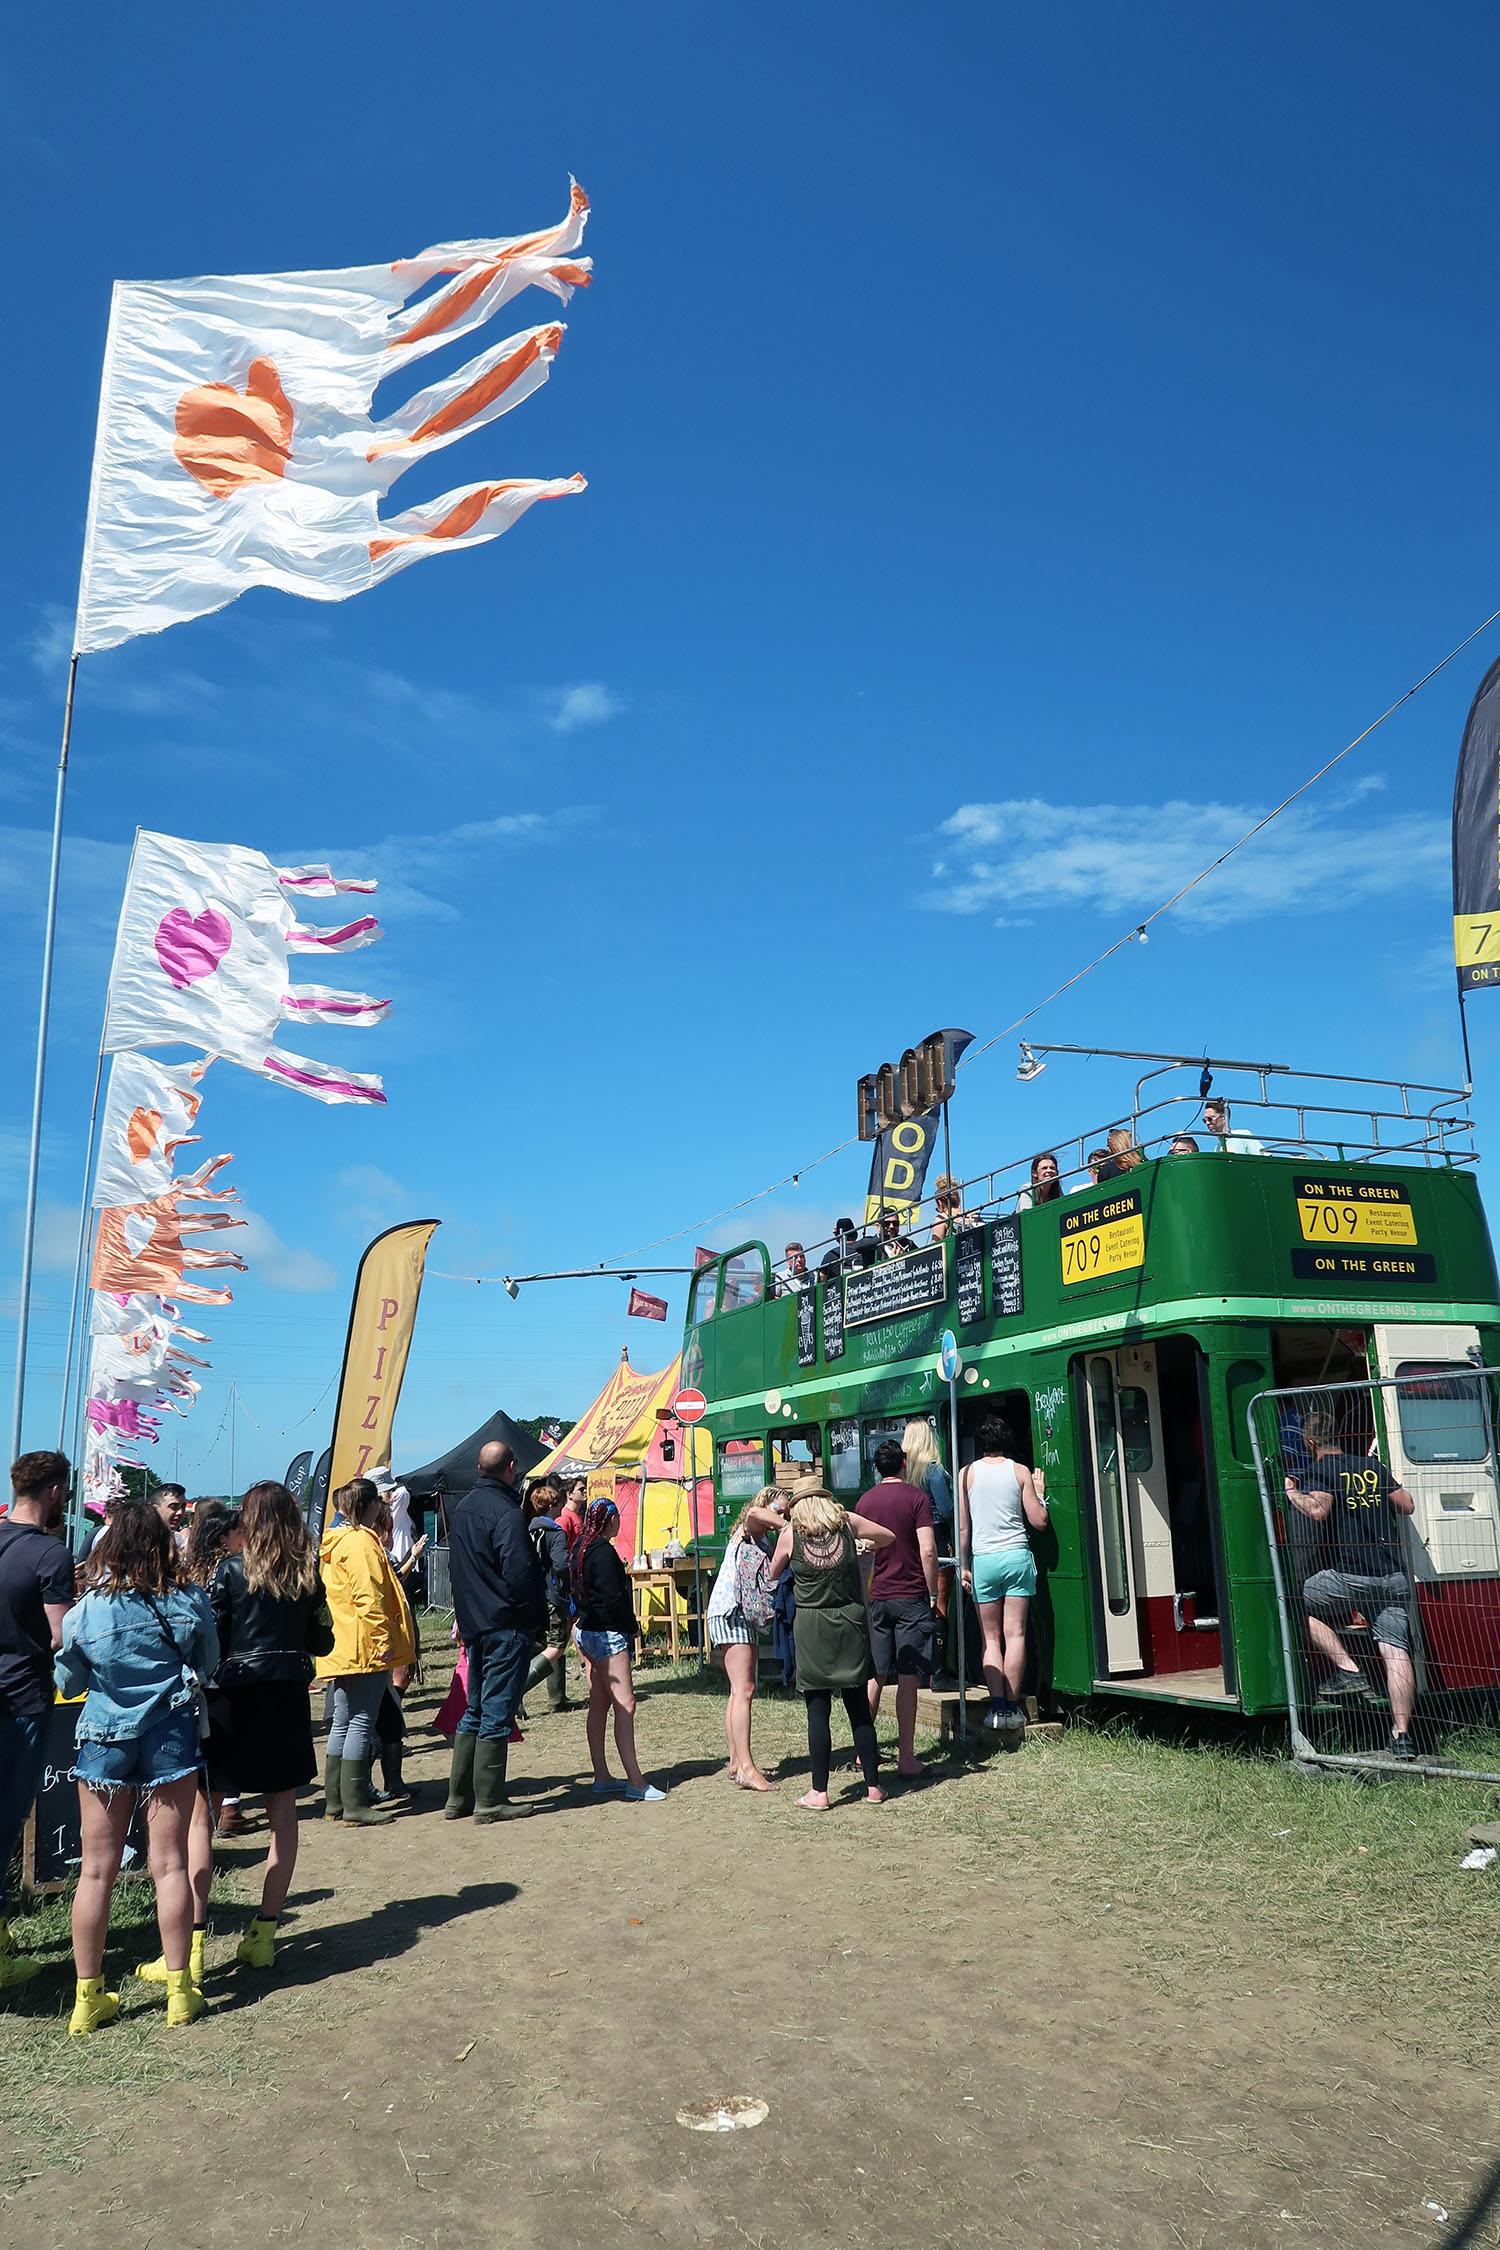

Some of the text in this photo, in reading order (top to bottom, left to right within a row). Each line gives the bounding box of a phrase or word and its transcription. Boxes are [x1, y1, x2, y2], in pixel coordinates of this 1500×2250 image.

[1472, 968, 1489, 981] ON
[1304, 1184, 1400, 1199] ON THE GREEN
[1066, 1198, 1134, 1230] ON THE GREEN
[1304, 1205, 1358, 1235] 709
[1369, 1209, 1402, 1218] Restaurant
[1365, 1219, 1410, 1229] Event Catering
[1109, 1226, 1135, 1239] Restaurant
[1371, 1228, 1408, 1237] Party Venue
[1105, 1236, 1140, 1252] Event Catering
[1065, 1235, 1101, 1275] 709
[1109, 1250, 1138, 1263] Party Venue
[1315, 1259, 1416, 1273] ON THE GREEN
[289, 1465, 307, 1497] Stop
[1339, 1469, 1381, 1510] 709 STAFF
